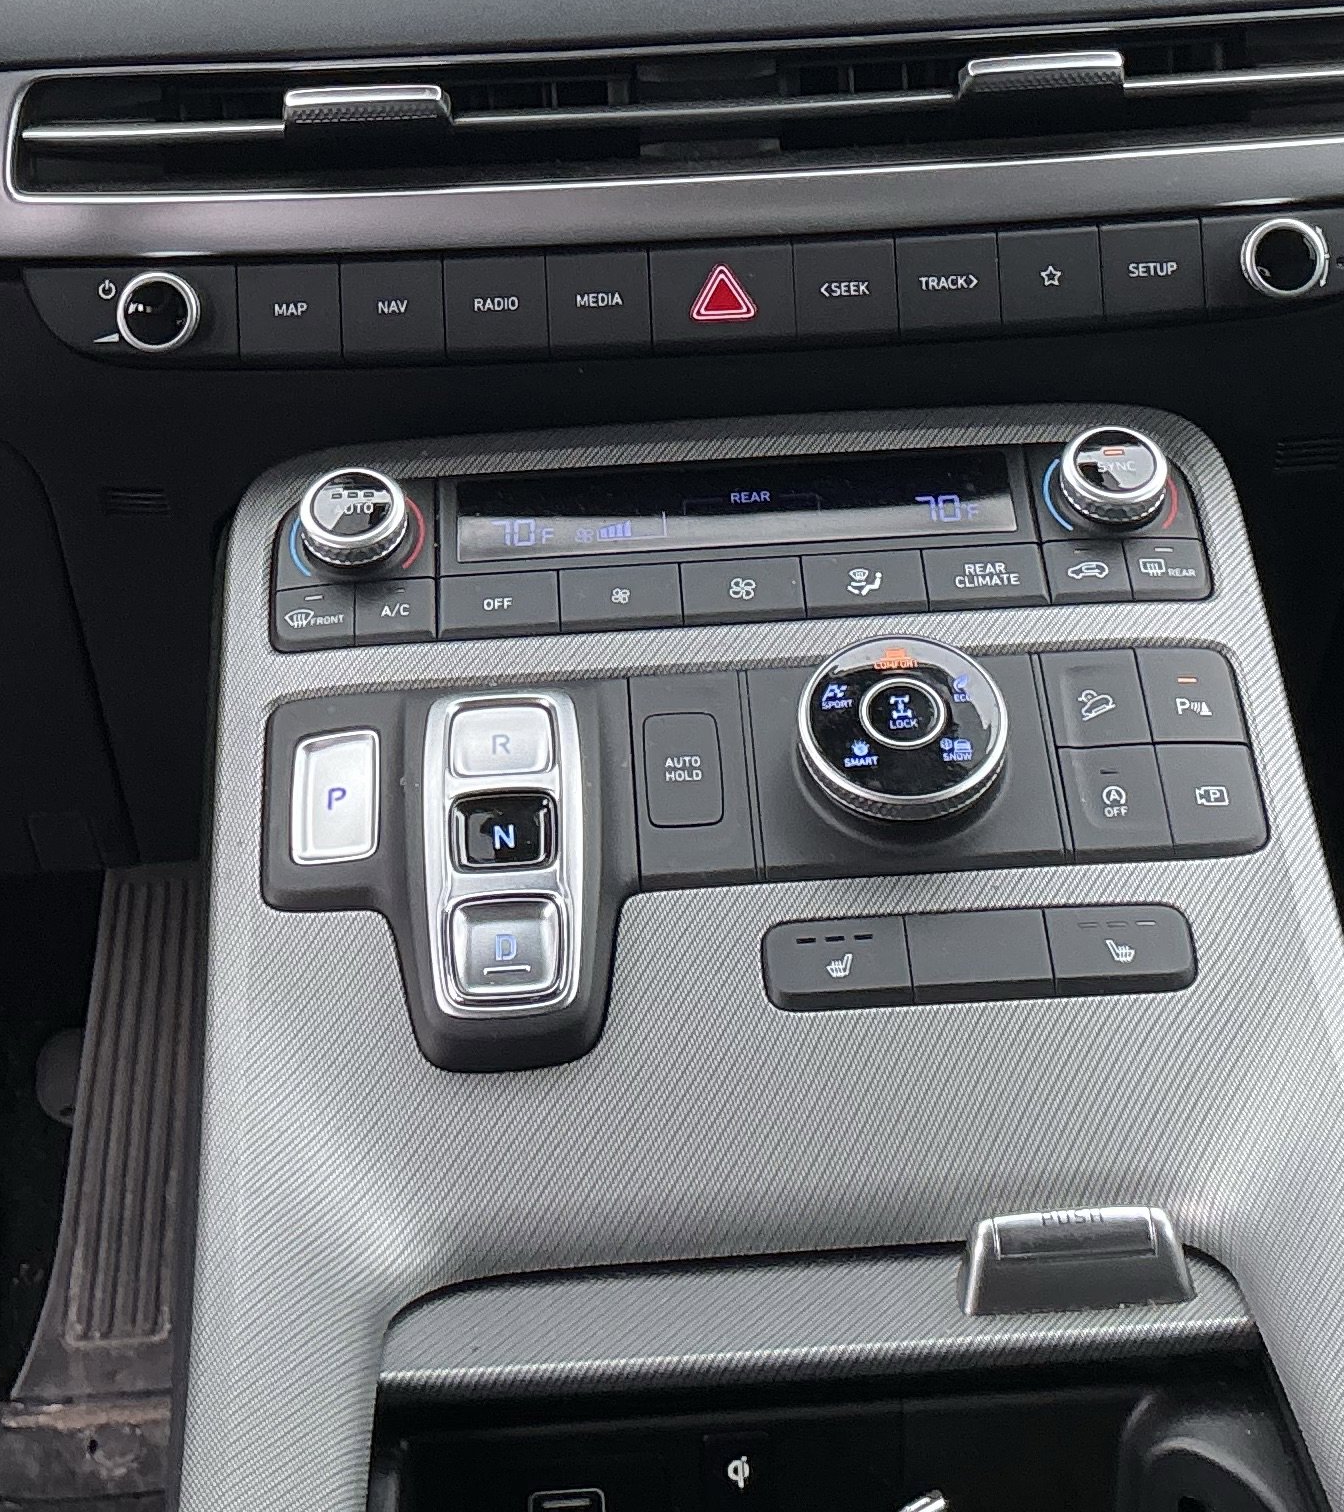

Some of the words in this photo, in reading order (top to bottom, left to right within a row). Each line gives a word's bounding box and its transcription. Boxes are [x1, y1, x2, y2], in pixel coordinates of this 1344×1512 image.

[1128, 261, 1178, 279] SETUP
[473, 294, 520, 312] RADIO
[575, 290, 623, 308] MEDIA
[273, 301, 308, 318] MAP
[377, 299, 408, 316] NAV
[1097, 460, 1137, 473] SYNC
[730, 490, 771, 505] REAR
[963, 562, 1007, 576] REAR
[1168, 567, 1197, 578] REAR
[954, 573, 1021, 589] CLIMATE
[380, 603, 411, 617] A/C
[483, 596, 513, 611] OFF
[310, 614, 345, 627] FRONT
[821, 700, 854, 711] SPORT
[889, 719, 919, 730] LOCK
[491, 734, 511, 755] R
[664, 755, 701, 769] AUTO
[843, 755, 880, 768] SMART
[943, 752, 973, 762] SNOW
[665, 768, 703, 782] HOLD
[327, 787, 347, 811] P
[1104, 805, 1129, 818] OFF
[492, 824, 516, 849] N
[494, 934, 518, 962] D
